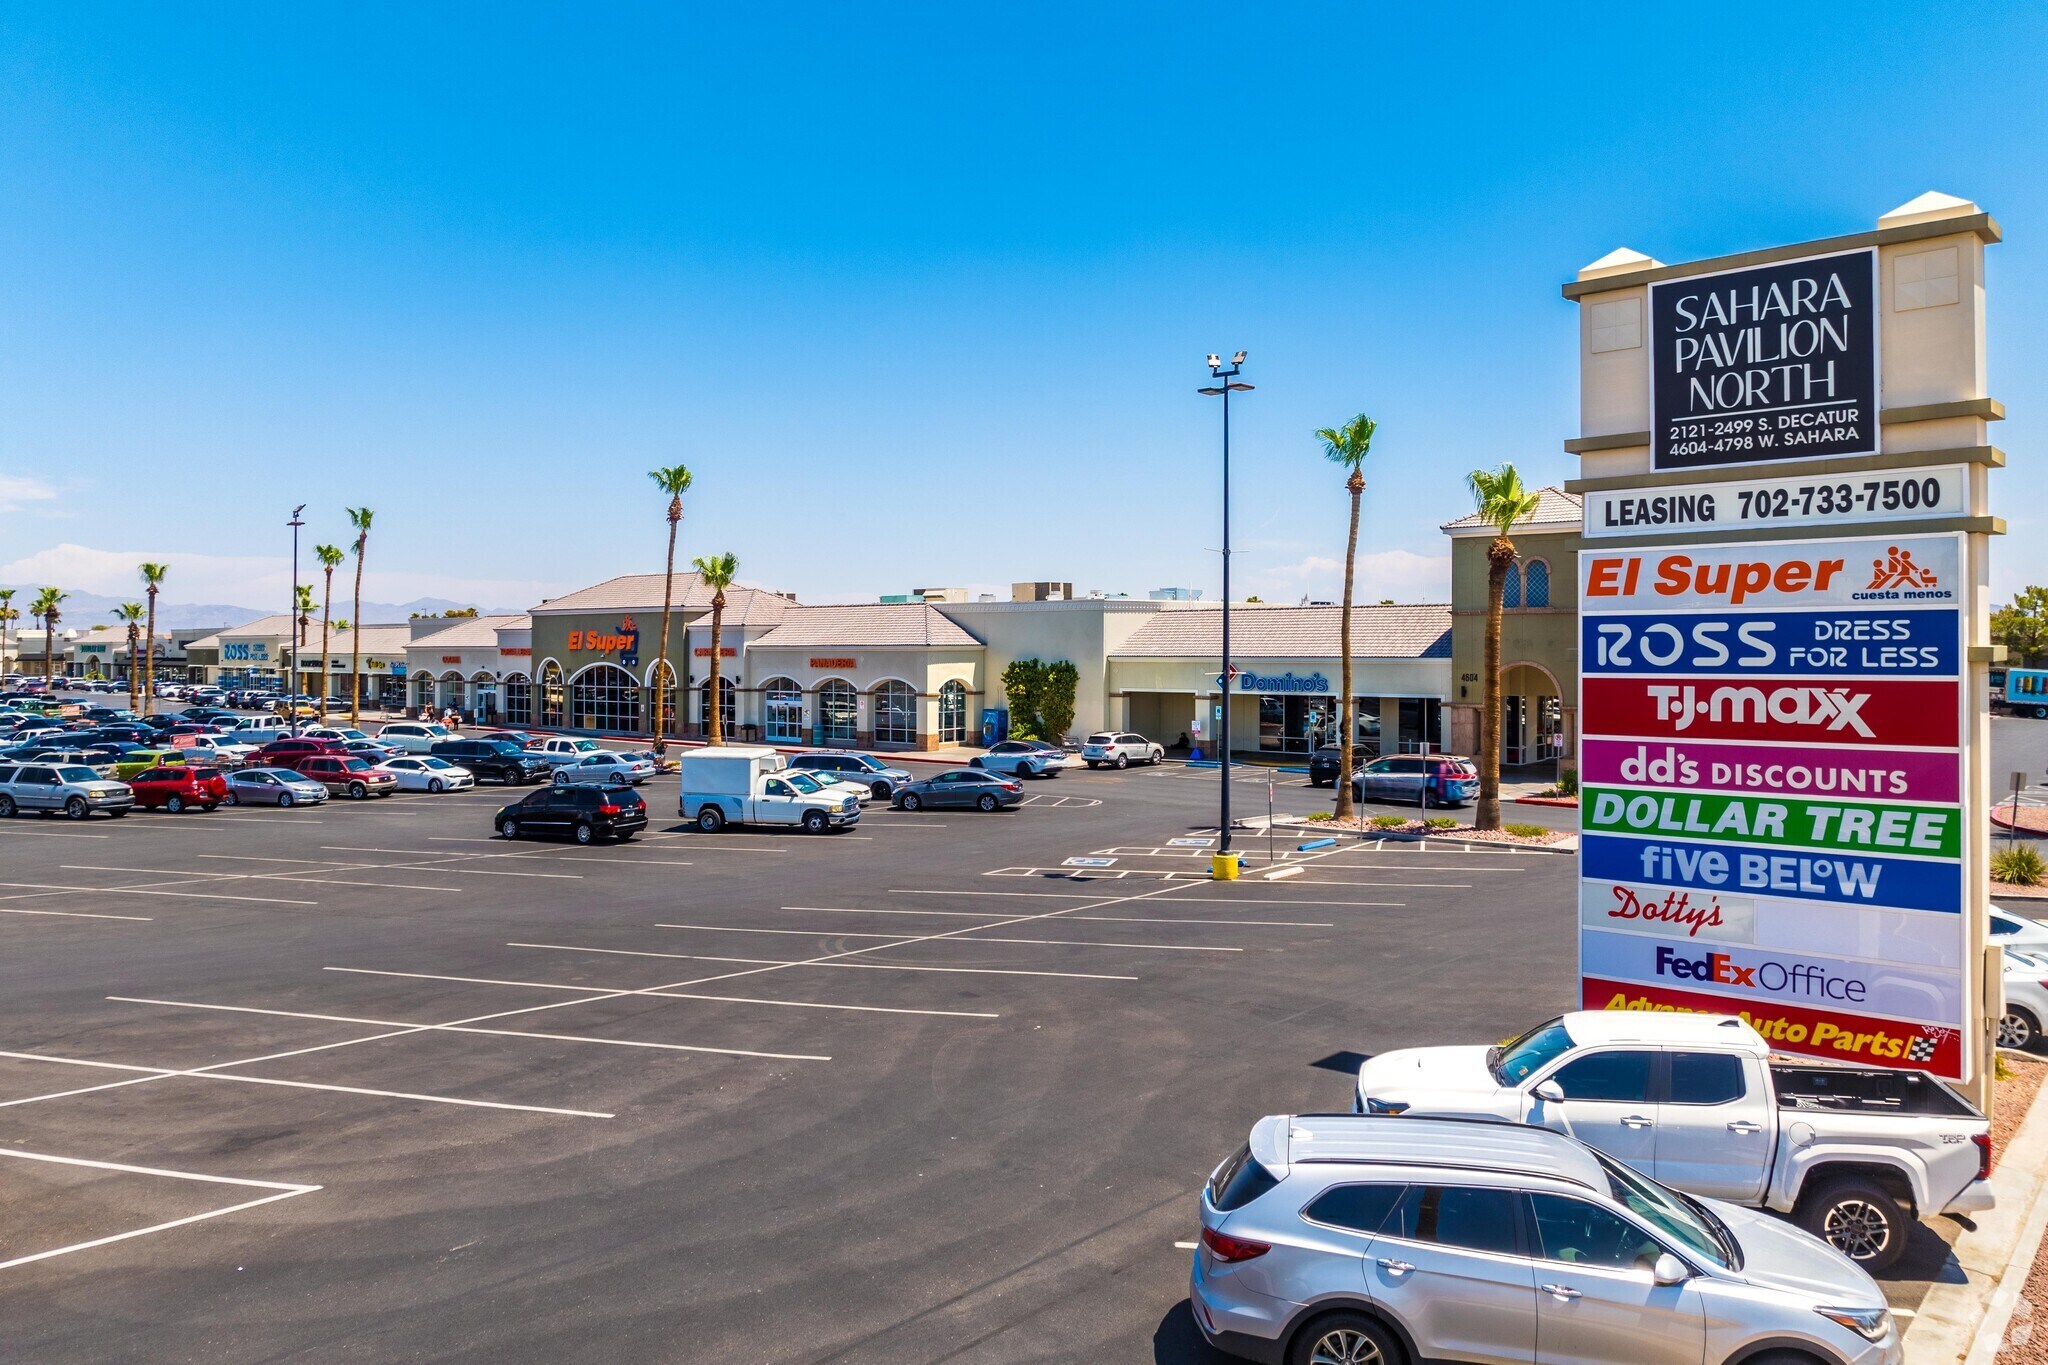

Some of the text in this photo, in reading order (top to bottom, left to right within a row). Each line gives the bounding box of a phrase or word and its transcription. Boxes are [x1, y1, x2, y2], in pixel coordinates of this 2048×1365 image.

[1675, 272, 1852, 333] SAHARA
[1675, 314, 1848, 374] PAVILION
[1690, 360, 1835, 412] NORTH
[1669, 408, 1859, 440] 2121-2499 S. DECATUR
[1669, 426, 1860, 457] 4604-4798 W. SAHARA
[1605, 477, 1941, 528] LEASING 702-733-7500
[1586, 555, 1845, 605] El Super
[1852, 588, 1952, 601] cuesta menos
[568, 630, 635, 654] El Super
[1597, 621, 1777, 667] ROSS
[1814, 619, 1911, 642] DRESS
[225, 644, 249, 660] ROSS
[809, 657, 857, 668] PANADERIA
[1789, 647, 1939, 668] FOR LESS
[1241, 672, 1329, 692] Domino's
[1461, 673, 1478, 682] 4604
[1620, 745, 1908, 794] dd's DISCOUNTS
[1592, 793, 1948, 850] DOLLAR TREE
[1608, 885, 1724, 937] Dotty's
[1810, 1021, 1904, 1060] Parts
